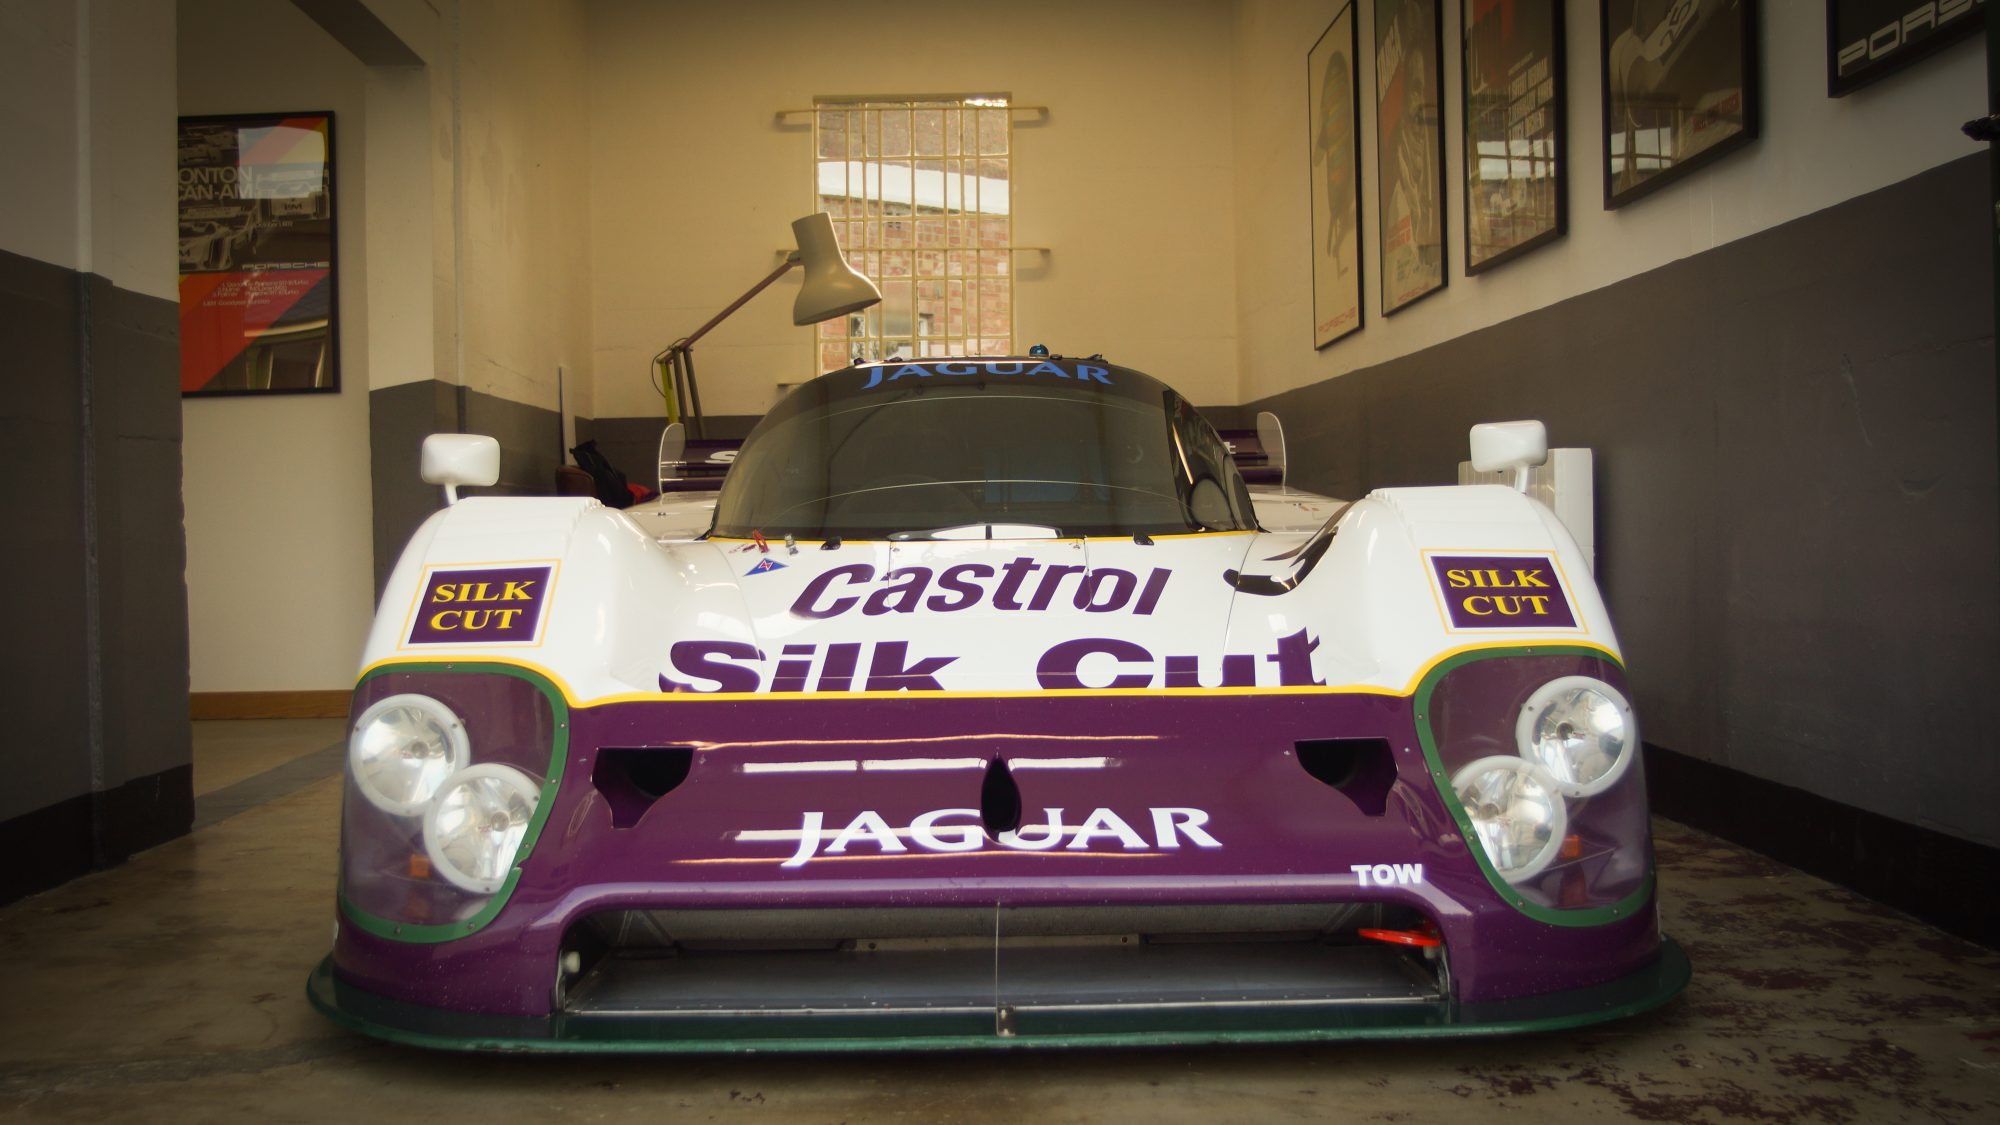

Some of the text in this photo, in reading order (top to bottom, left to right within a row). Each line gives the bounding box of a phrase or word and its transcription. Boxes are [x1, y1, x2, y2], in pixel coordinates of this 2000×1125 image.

[1838, 0, 1985, 77] PORS
[861, 362, 1114, 390] JAGUAR
[788, 556, 1172, 619] Castrol
[1446, 569, 1550, 588] SILK
[431, 581, 535, 603] SILK
[1463, 596, 1549, 616] CUT
[430, 609, 522, 630] CUT
[658, 626, 1327, 693] Silk Cut
[780, 807, 1223, 868] JAGUAR
[1350, 862, 1424, 887] TOW
